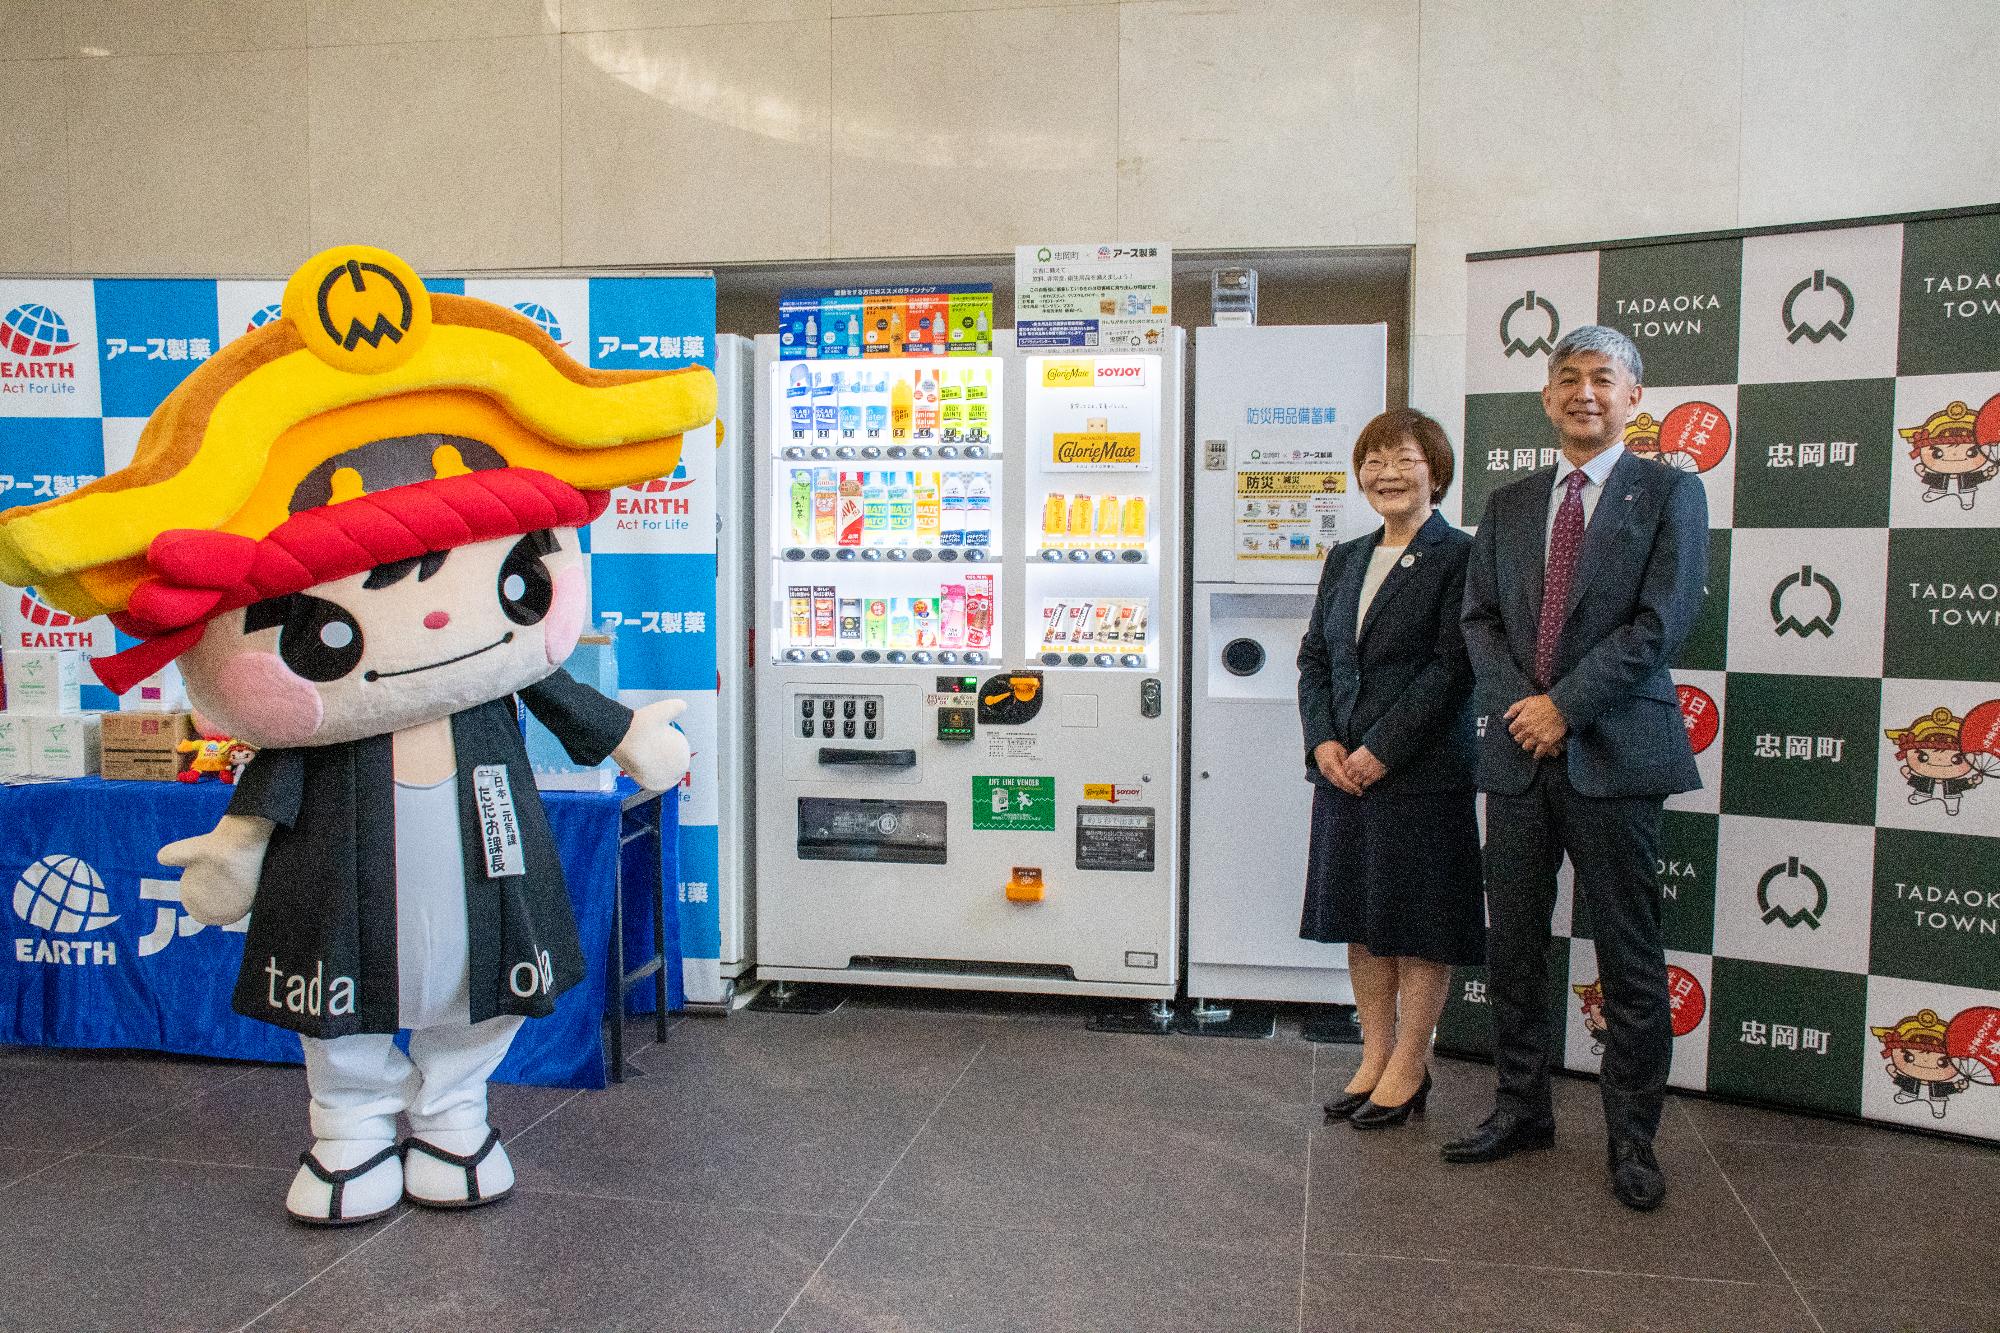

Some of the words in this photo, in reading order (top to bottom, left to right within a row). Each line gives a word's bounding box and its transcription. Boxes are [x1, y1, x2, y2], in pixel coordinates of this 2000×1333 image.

[1113, 247, 1158, 258] アース製薬
[1616, 294, 1720, 314] TADAOKA
[1943, 300, 2000, 318] TOW
[1633, 320, 1701, 337] TOWN
[105, 338, 211, 360] アース製薬
[598, 336, 705, 358] アース製薬
[1, 363, 75, 378] EARTH
[1047, 368, 1090, 381] CalorieMate
[1097, 367, 1141, 377] SOYJOY
[3, 384, 25, 394] Act
[30, 384, 48, 394] For
[52, 383, 76, 394] Life
[1247, 407, 1337, 425] 防災用品備蓄庫
[1687, 412, 1719, 455] 日本一
[1057, 441, 1136, 463] CalorieMate
[1486, 448, 1562, 471] 忠岡町
[1766, 442, 1859, 467] 忠岡町
[616, 499, 689, 514] EARTH
[617, 519, 638, 529] Act
[643, 520, 661, 529] For
[665, 519, 689, 529] Life
[1909, 583, 2000, 600] TADAO
[601, 611, 706, 633] アース製薬
[21, 632, 93, 647] EARTH
[1755, 733, 1845, 762] 忠岡町
[988, 778, 1001, 786] LIFE
[1017, 779, 1040, 787] VENDER
[478, 786, 505, 873] ただお課長
[1895, 884, 2000, 908] TADAOK
[1914, 911, 1998, 934] TOWN
[15, 939, 117, 965] EARTH
[265, 957, 356, 1017] tada
[1740, 1021, 1831, 1055] 忠岡町
